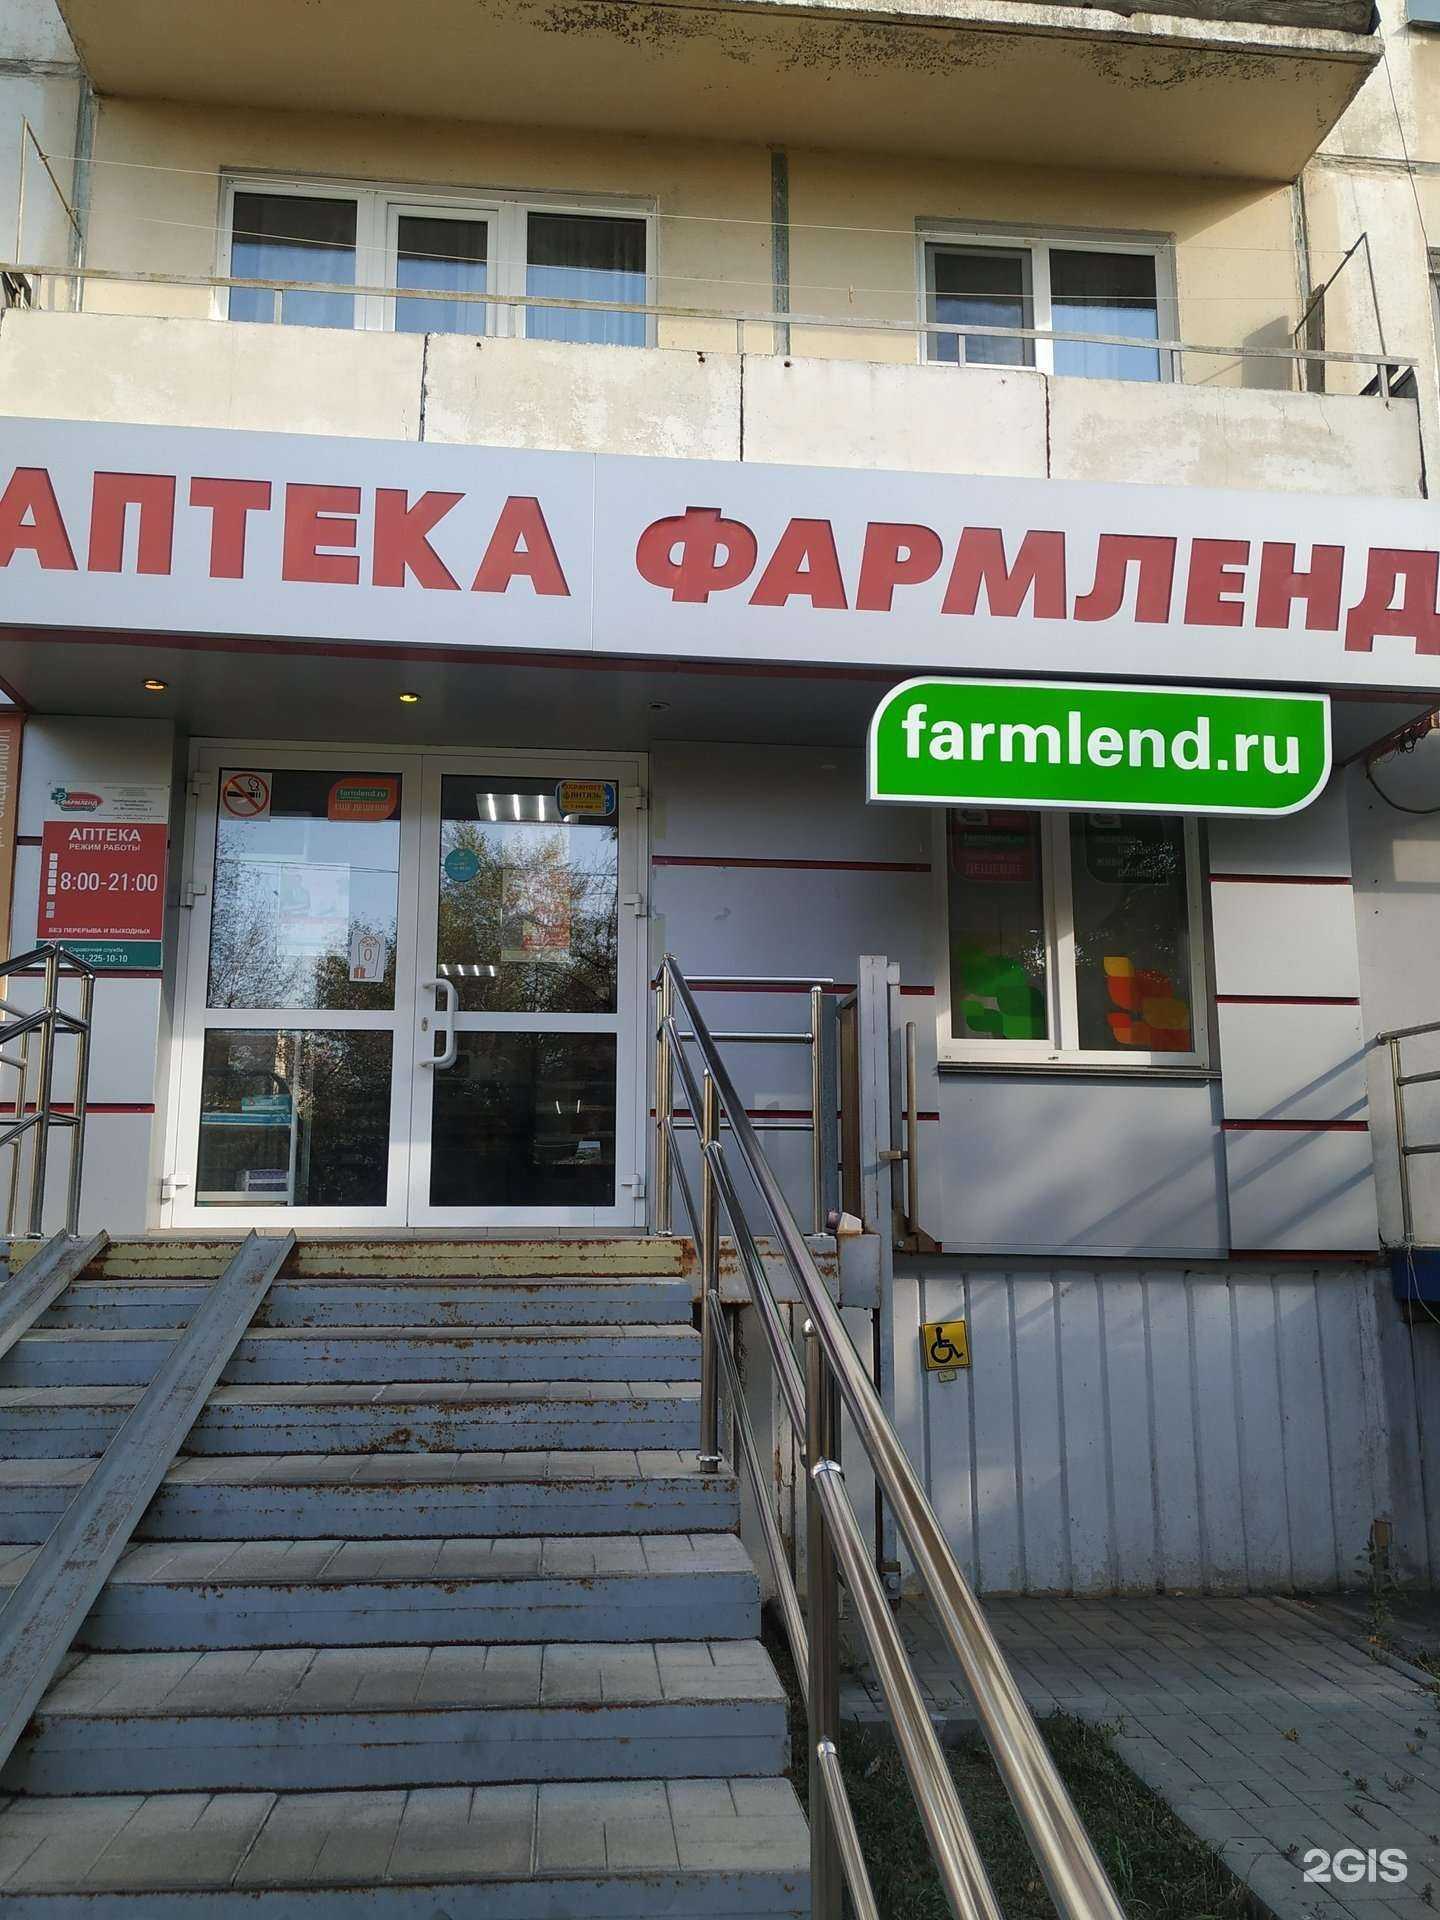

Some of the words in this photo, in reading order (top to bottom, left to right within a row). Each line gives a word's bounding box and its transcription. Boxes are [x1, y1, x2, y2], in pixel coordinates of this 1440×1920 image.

[0, 466, 571, 597] АПТЕКА
[635, 505, 1440, 656] ФАРМЛЕНД
[901, 703, 1300, 774] farmlend.ru
[69, 827, 142, 842] АПТЕКА
[69, 843, 101, 851] РЕЖИМ
[60, 872, 158, 892] 8:00-21:00
